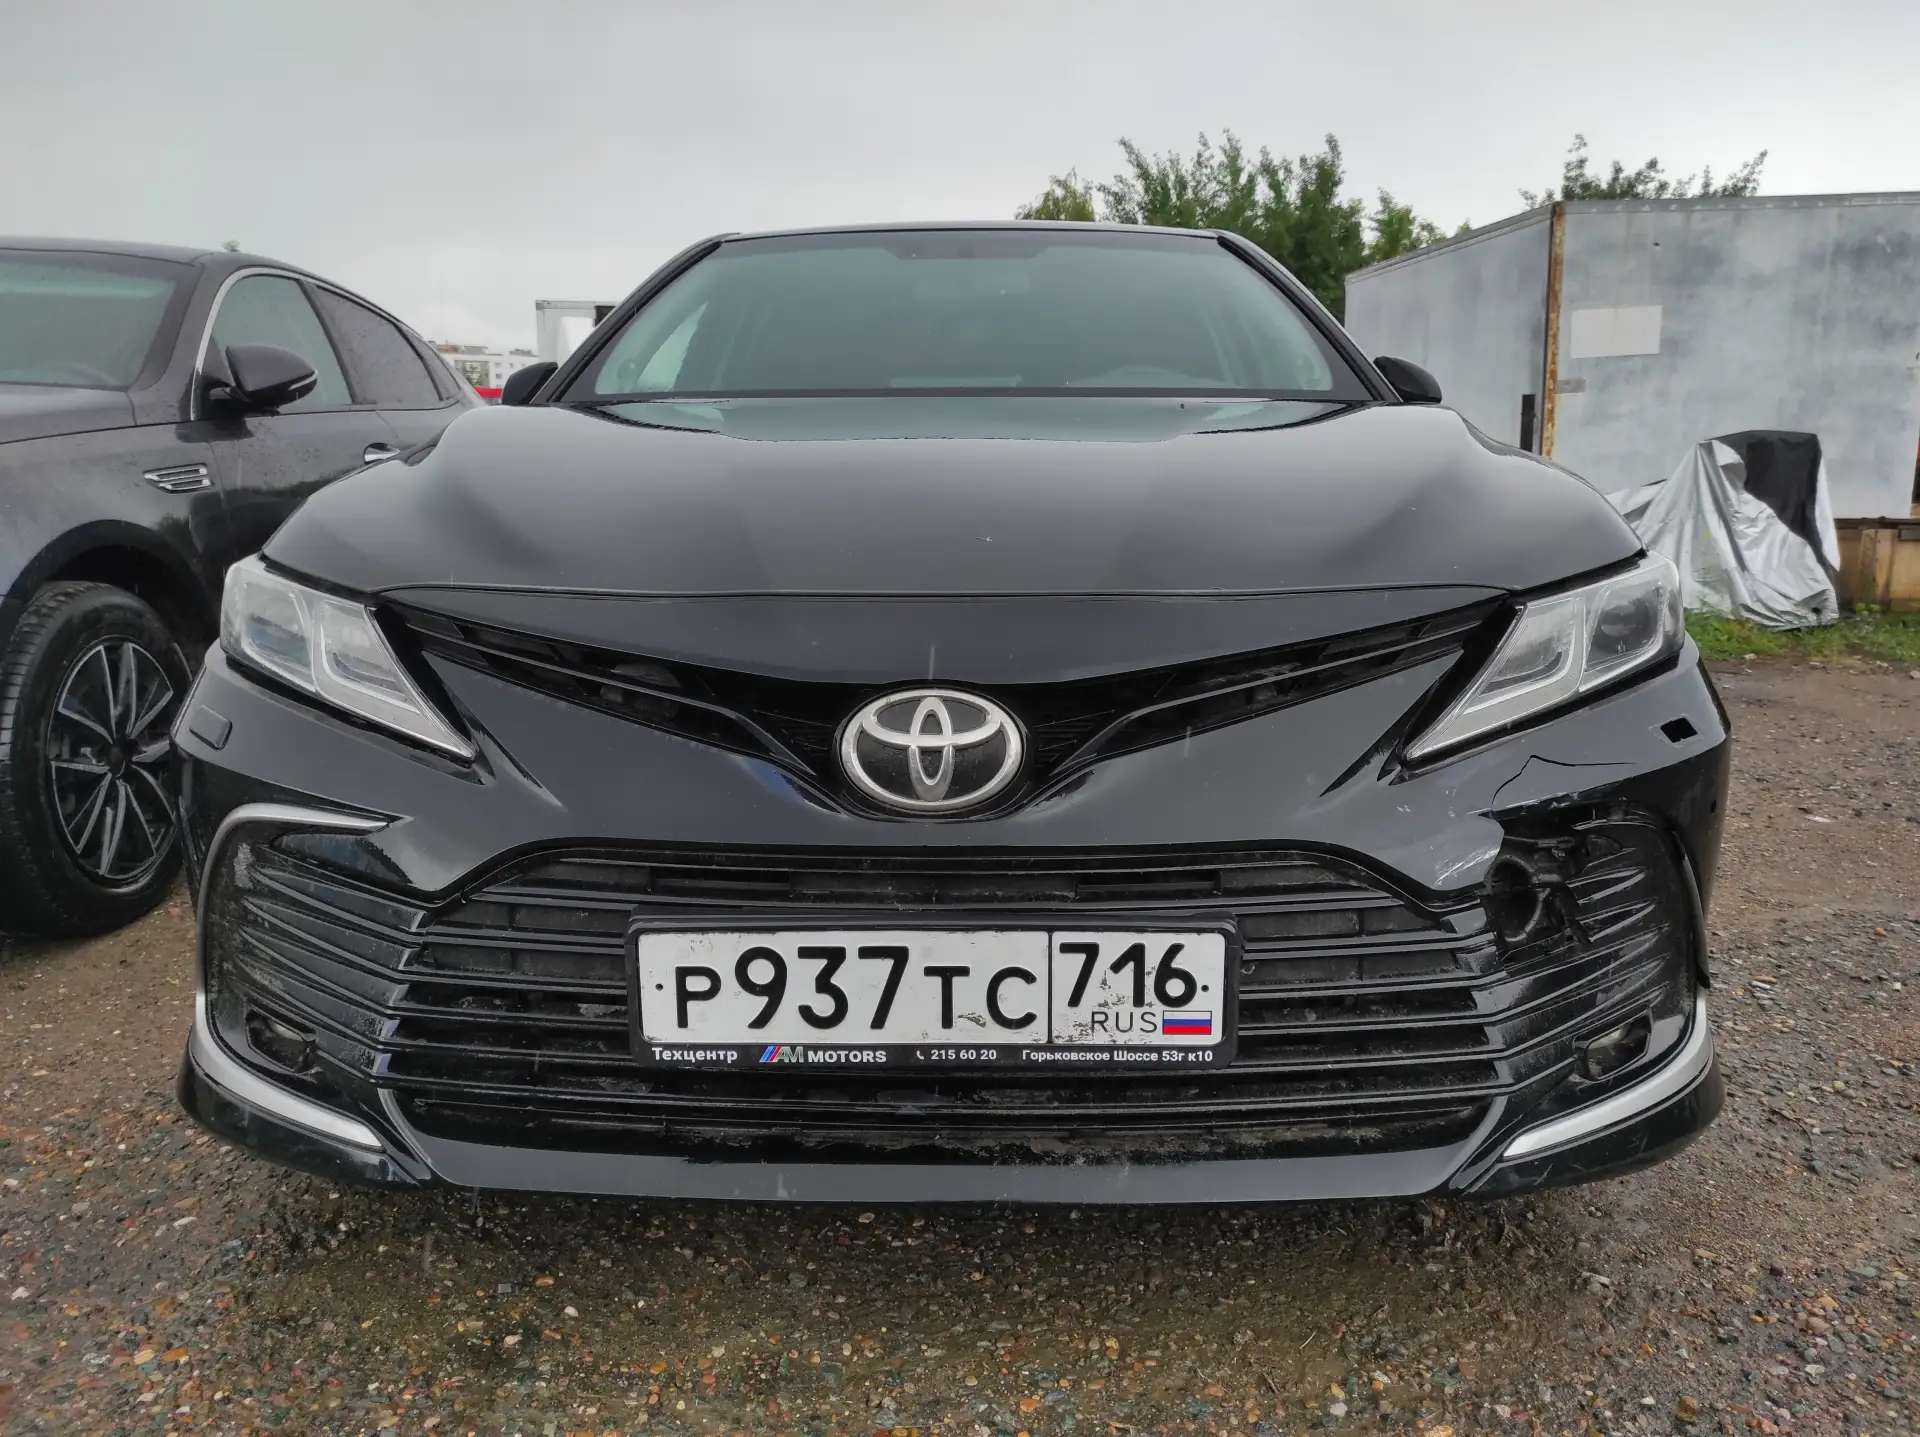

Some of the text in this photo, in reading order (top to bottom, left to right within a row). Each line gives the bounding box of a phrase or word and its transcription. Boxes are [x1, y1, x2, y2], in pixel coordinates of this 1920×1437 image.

[1058, 942, 1198, 1008] 716
[1091, 1010, 1159, 1034] RUS
[652, 1047, 738, 1063] Техцентр
[808, 1050, 887, 1063] MOTORS
[930, 1049, 997, 1060] 215 60 20
[1022, 1049, 1213, 1062] Горьковское Шоссе 53г к10
